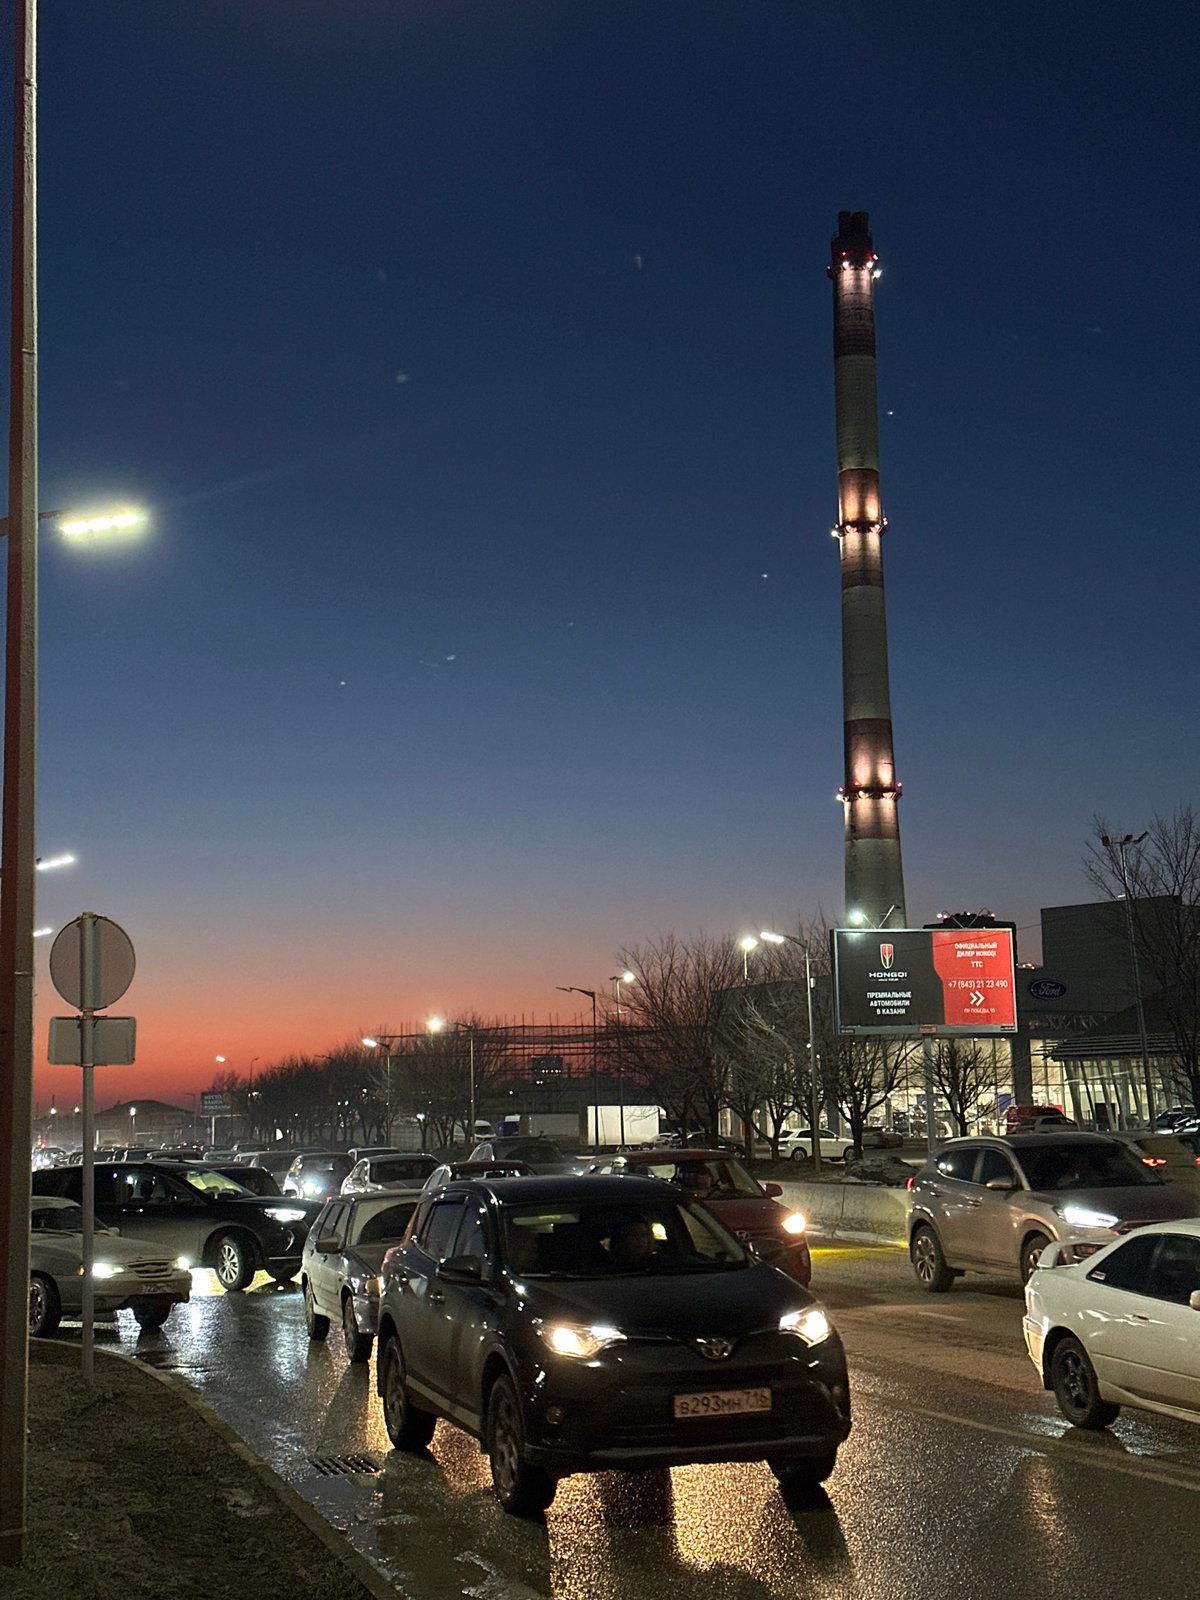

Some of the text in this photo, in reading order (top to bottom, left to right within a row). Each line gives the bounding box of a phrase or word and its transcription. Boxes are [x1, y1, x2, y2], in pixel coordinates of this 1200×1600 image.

[954, 942, 998, 950] ОФИЦИАЛЬНЫЙ
[948, 980, 1008, 990] +7 (843) 21 23 490
[1038, 982, 1061, 996] Ford
[869, 999, 910, 1007] АВТОМОБИЛИ
